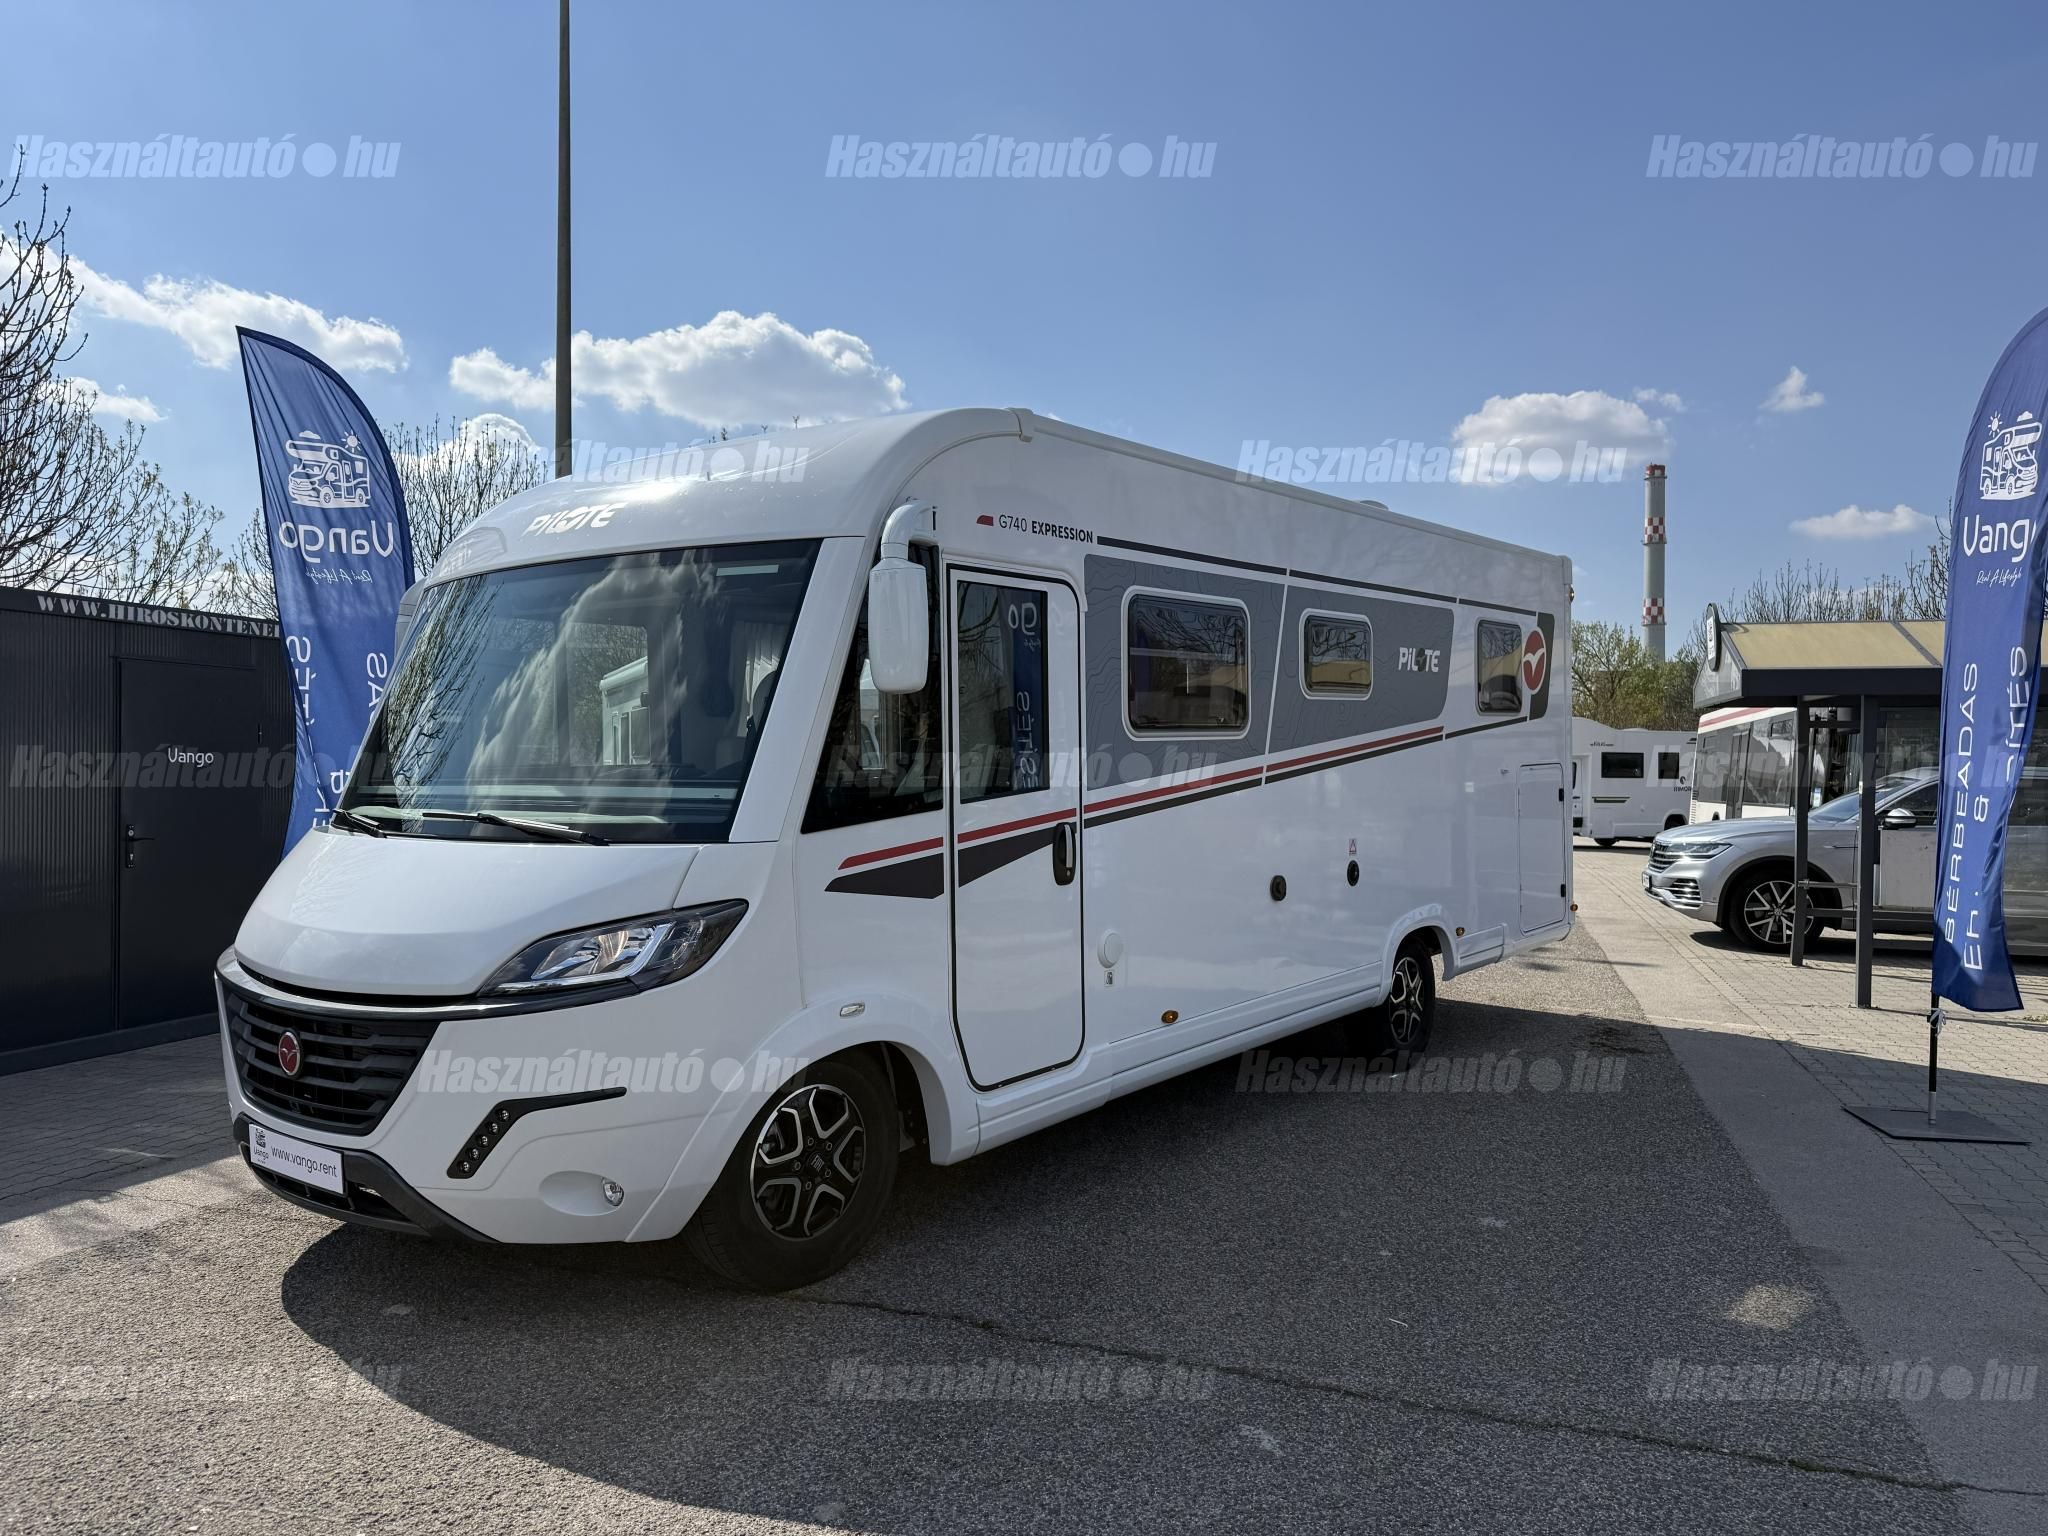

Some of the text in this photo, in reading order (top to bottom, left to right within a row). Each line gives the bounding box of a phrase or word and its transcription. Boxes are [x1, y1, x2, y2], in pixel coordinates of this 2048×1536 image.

[999, 514, 1093, 543] G740 EXPRESSION
[1963, 514, 2036, 563] Vang
[167, 747, 214, 768] Vango
[1944, 663, 1978, 944] BÉRBEADÁS
[253, 1145, 338, 1178] Vango www.vango.rent
